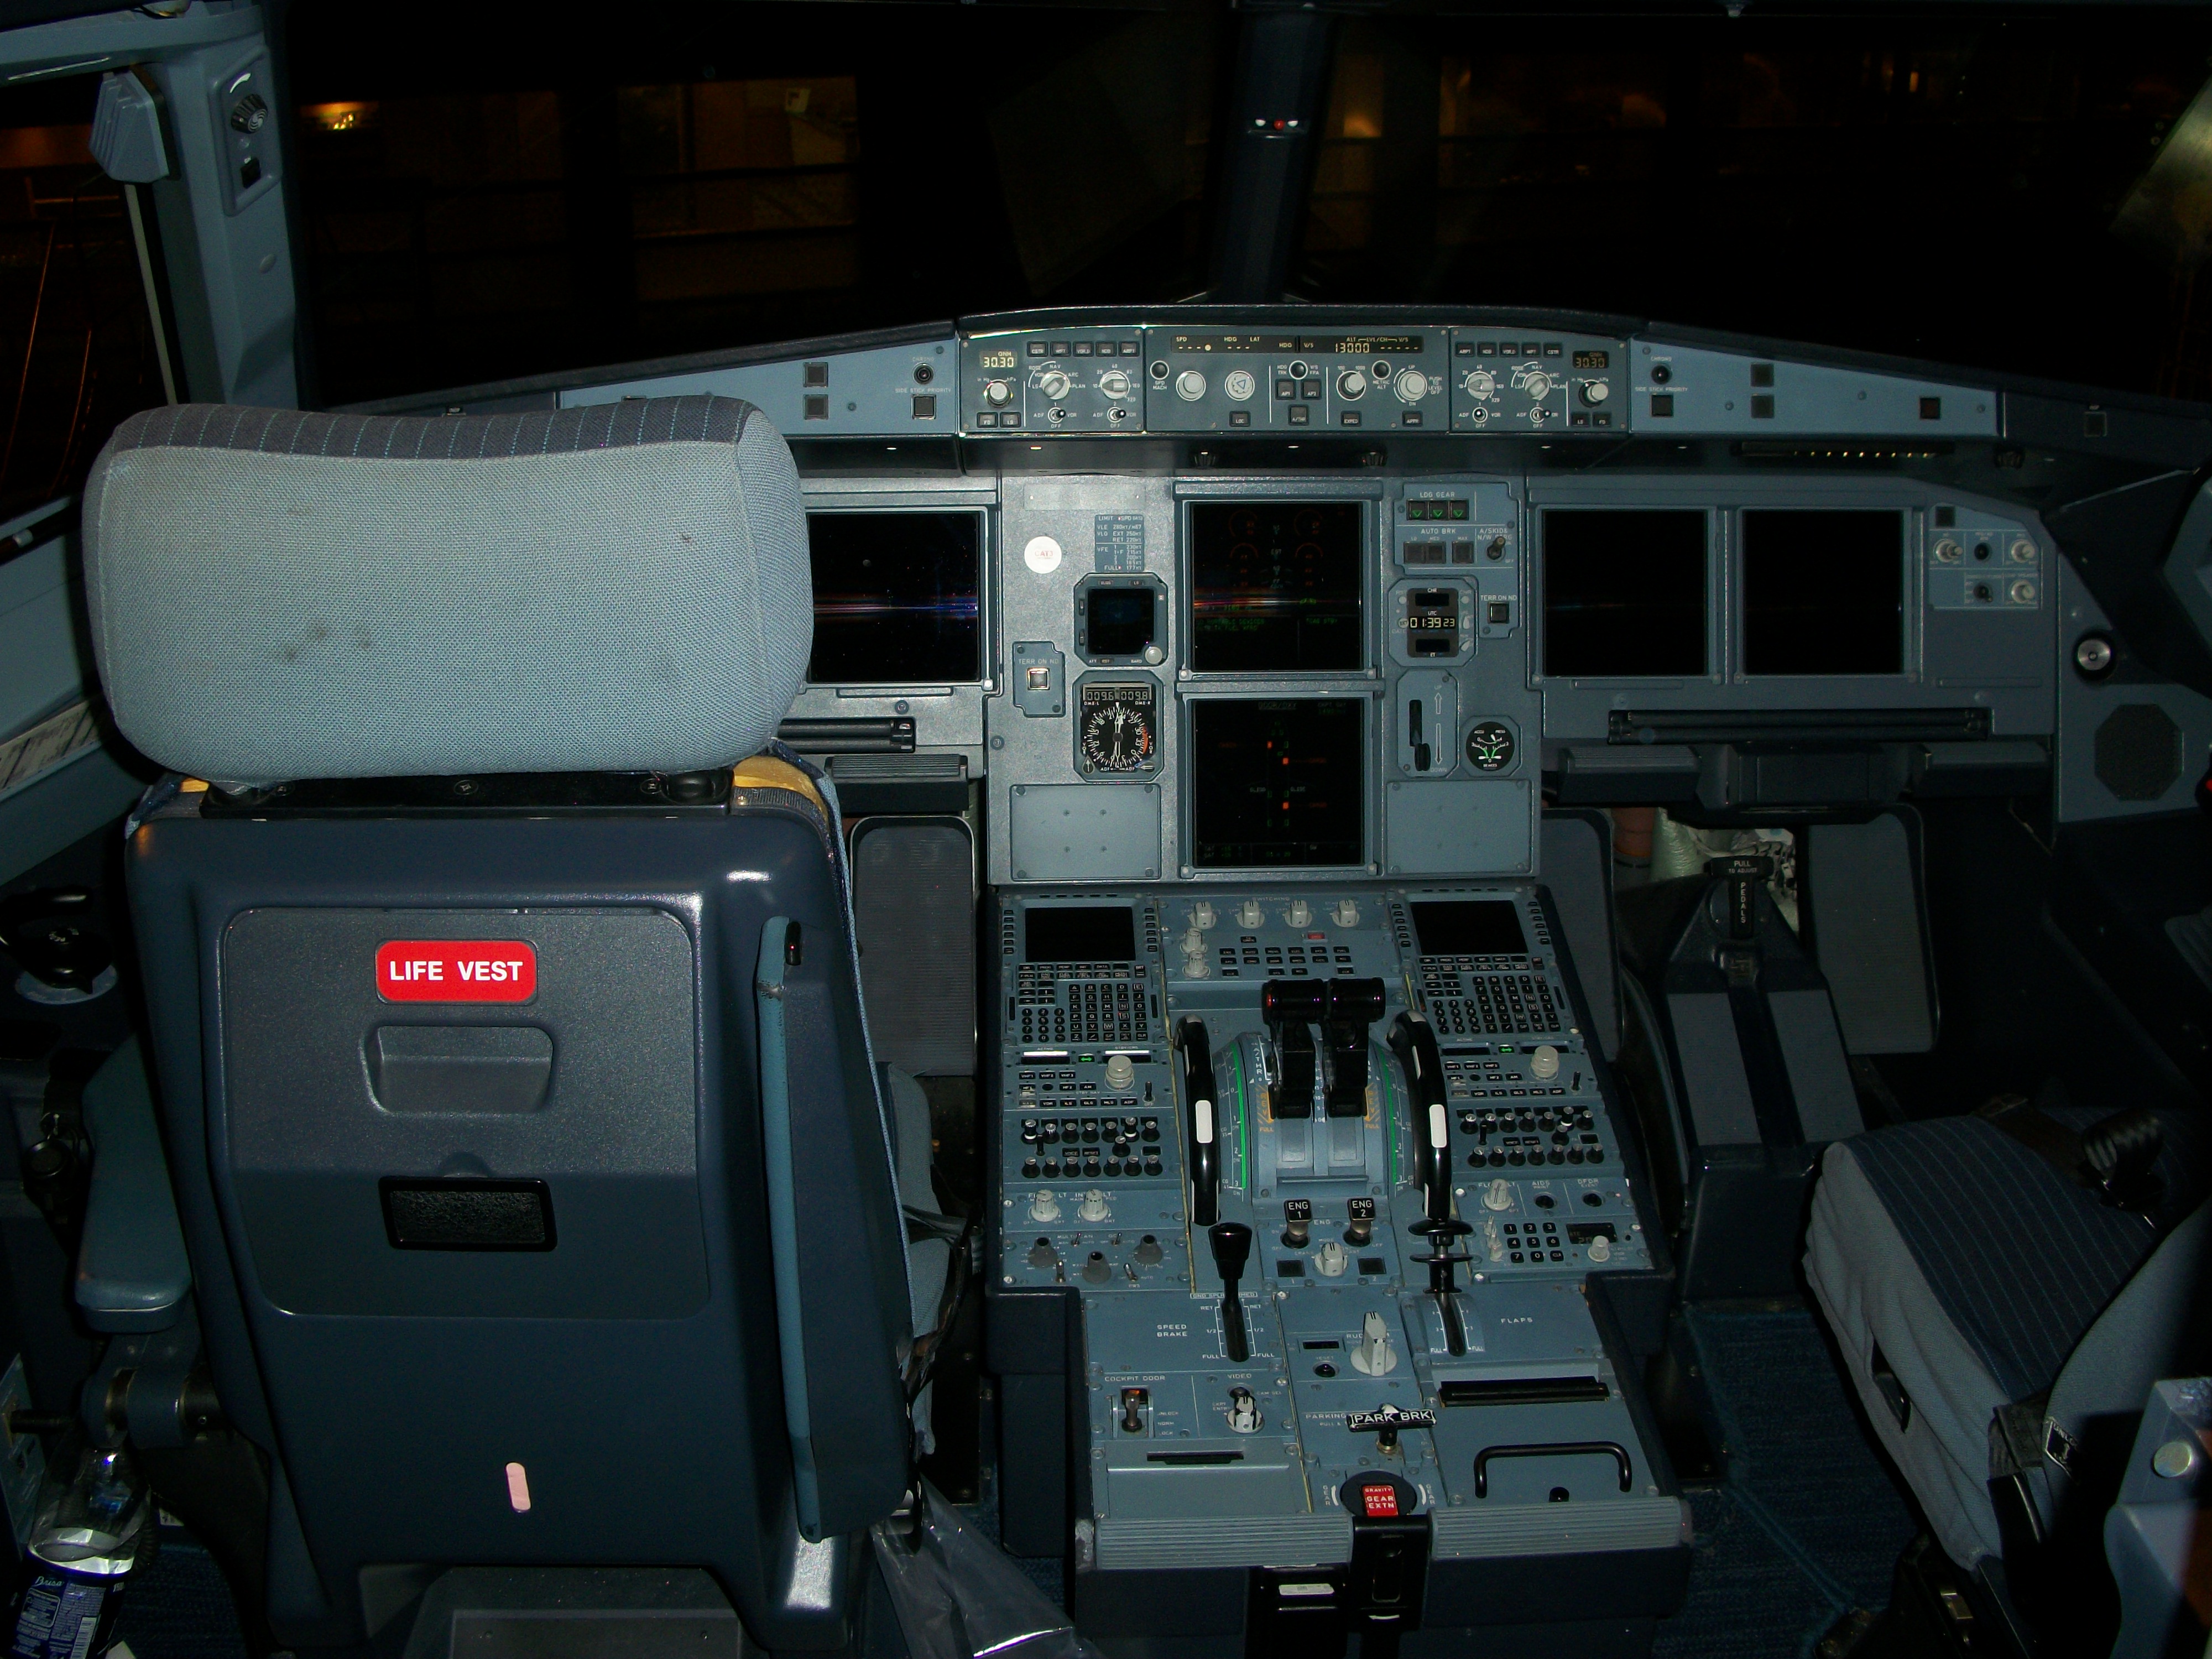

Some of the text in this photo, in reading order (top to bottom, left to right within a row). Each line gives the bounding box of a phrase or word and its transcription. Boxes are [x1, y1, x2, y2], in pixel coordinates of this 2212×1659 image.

[1335, 342, 1370, 353] 13000
[389, 961, 523, 981] LIFE VEST
[1288, 1201, 1309, 1210] ENG
[1352, 1200, 1373, 1208] ENG
[1360, 1209, 1366, 1217] 2
[1354, 1411, 1430, 1423] PARK BRK
